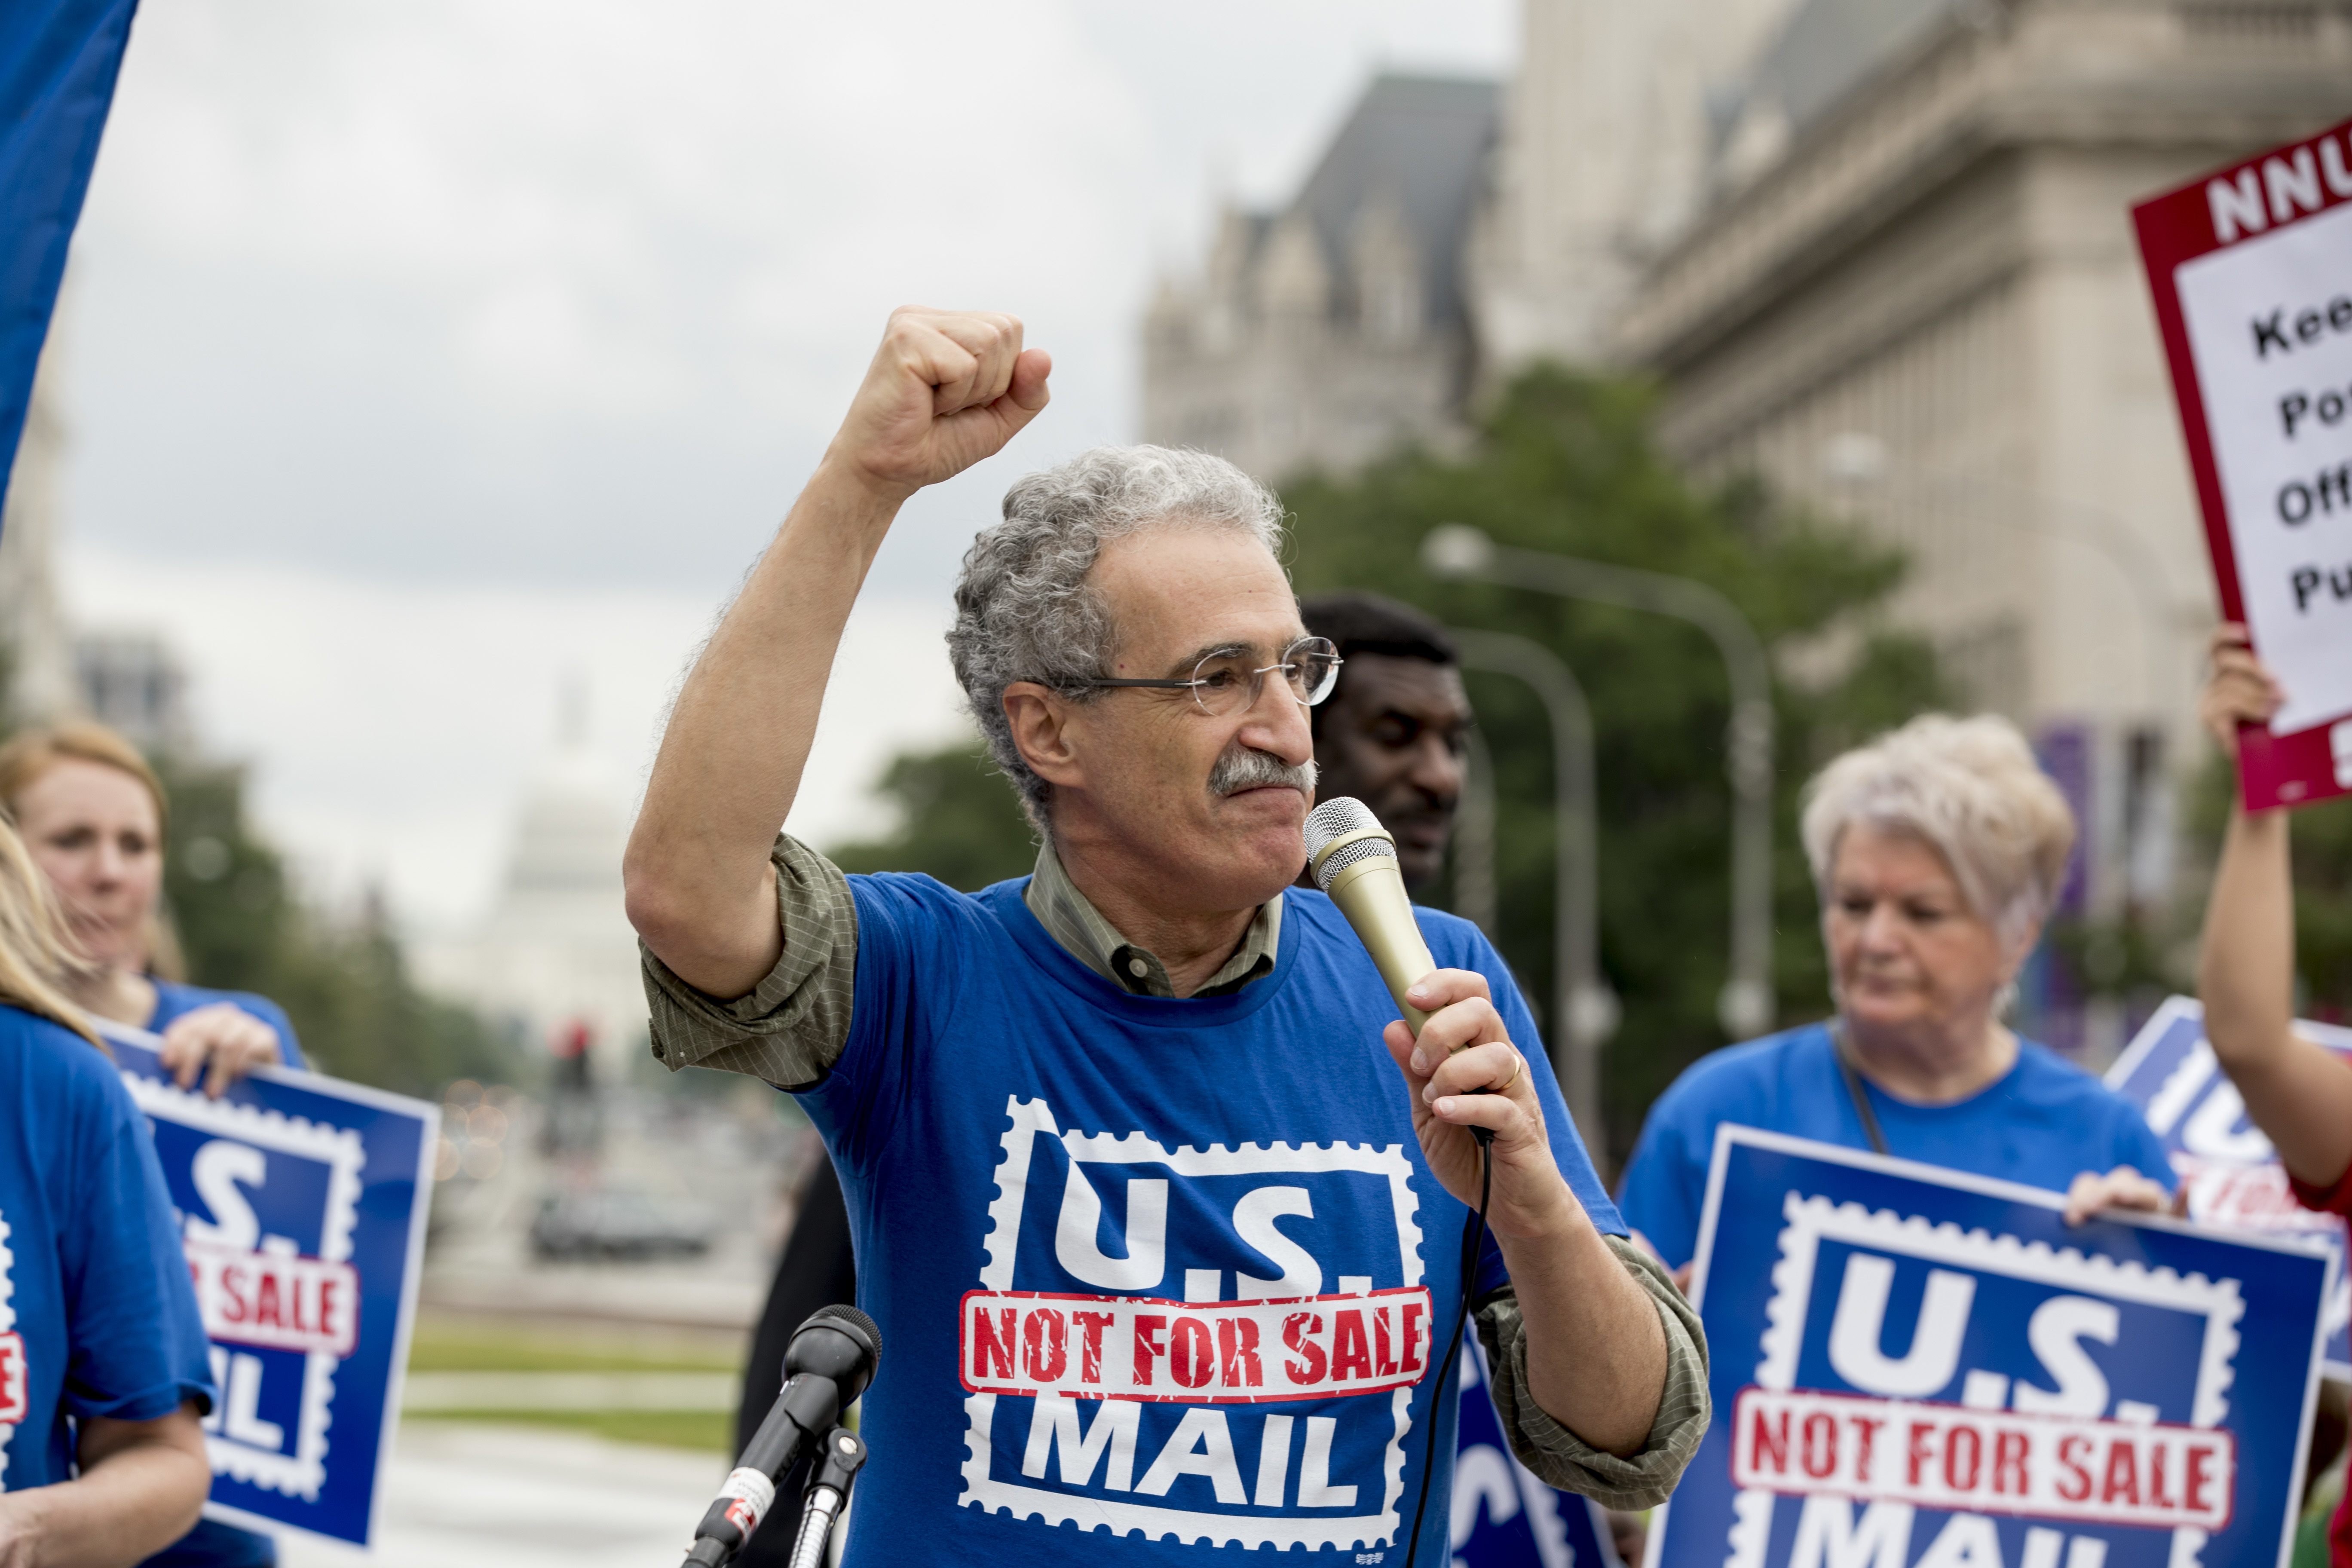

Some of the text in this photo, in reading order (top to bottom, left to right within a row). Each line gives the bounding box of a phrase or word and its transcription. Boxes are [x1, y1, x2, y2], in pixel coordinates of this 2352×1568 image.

[2279, 380, 2352, 435] Po
[1055, 1156, 1373, 1303] U.S.
[221, 1265, 339, 1337] SALE
[972, 1302, 1425, 1389] NOT FOR SALE
[1828, 1252, 2160, 1424] U.S.
[1021, 1393, 1358, 1508] MAIL
[1750, 1406, 2216, 1513] NOT FOR SALE
